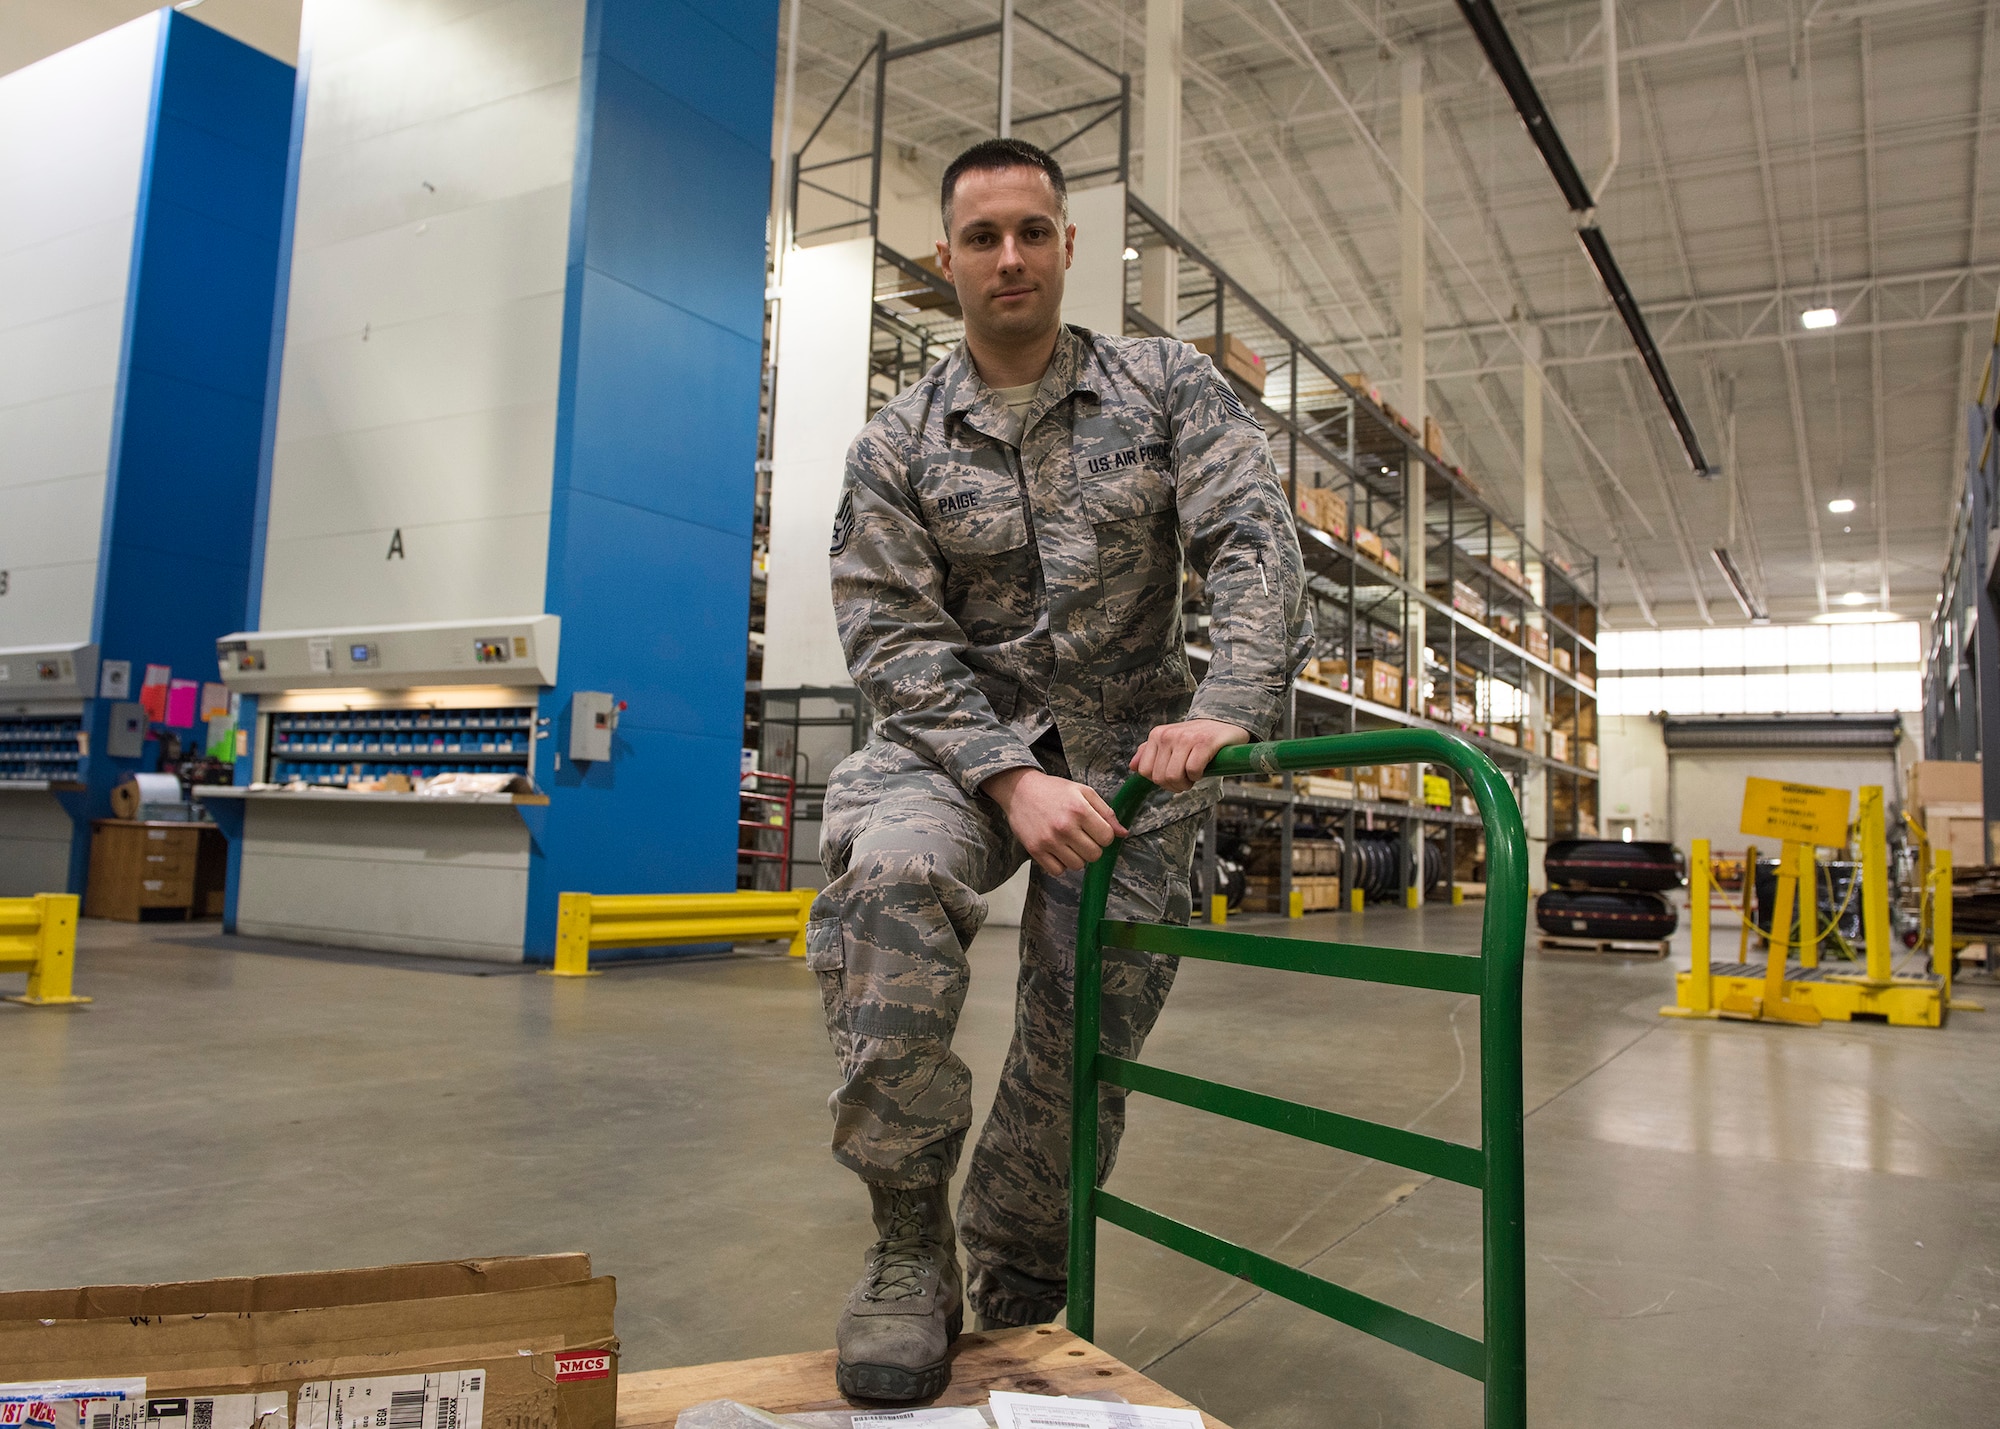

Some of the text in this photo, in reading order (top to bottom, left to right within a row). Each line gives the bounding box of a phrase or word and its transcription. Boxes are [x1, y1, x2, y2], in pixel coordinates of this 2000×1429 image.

[1088, 443, 1169, 474] U.S. AIR FORCE
[938, 491, 978, 515] PAIGE
[386, 527, 404, 560] A
[559, 1358, 605, 1373] NMCS
[0, 1403, 25, 1423] IST
[153, 1403, 179, 1415] 1
[375, 1407, 388, 1427] GEGA
